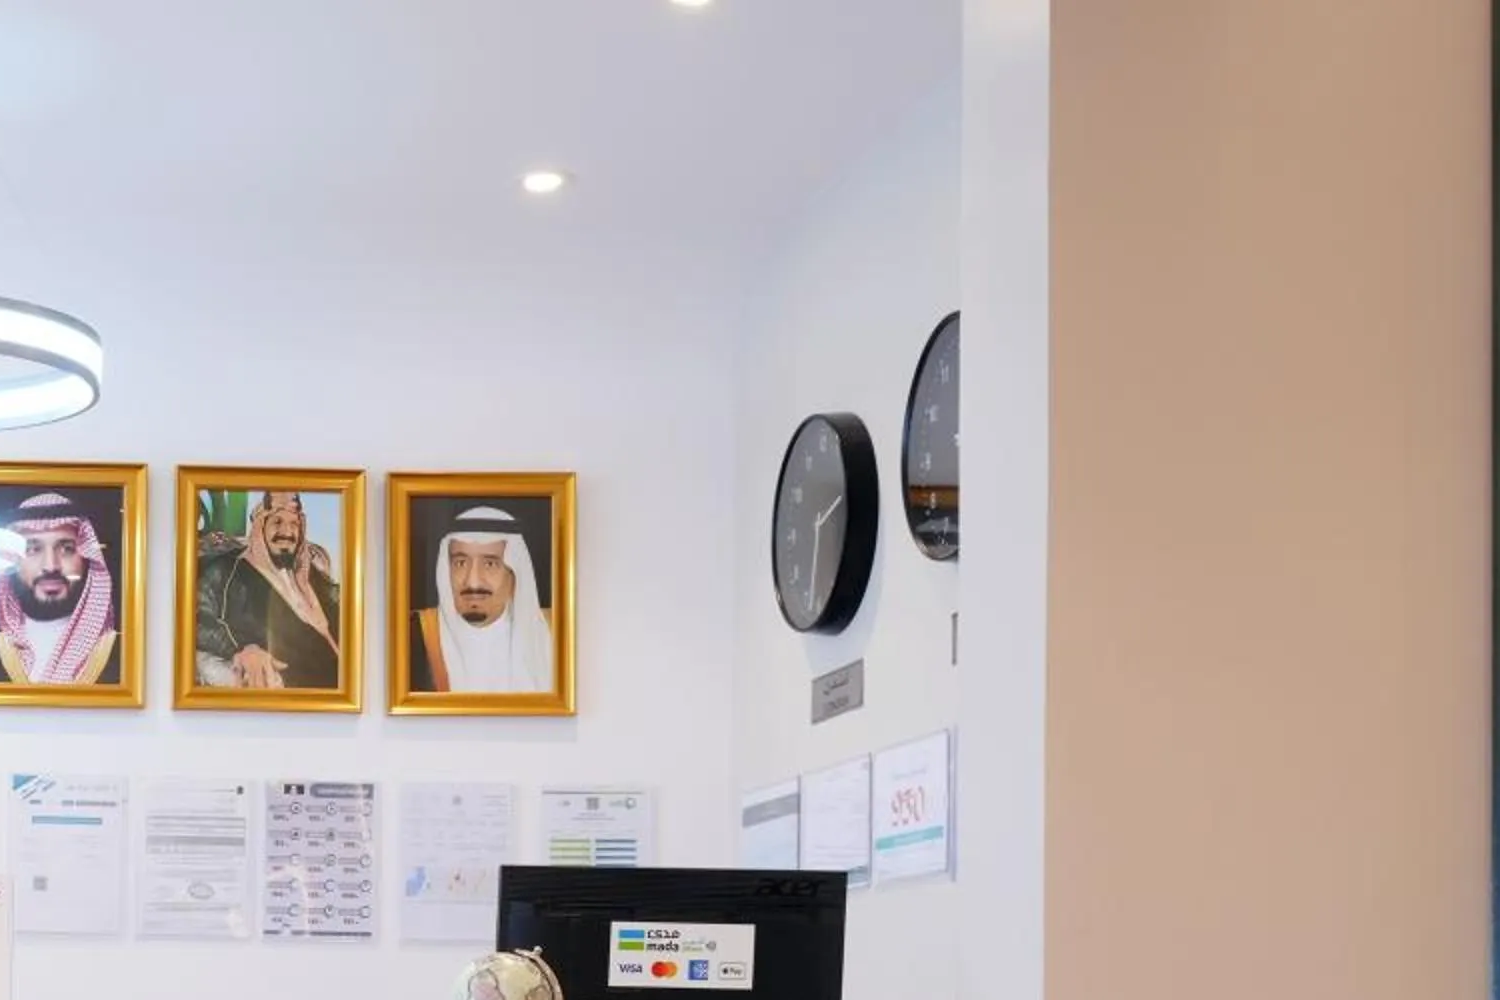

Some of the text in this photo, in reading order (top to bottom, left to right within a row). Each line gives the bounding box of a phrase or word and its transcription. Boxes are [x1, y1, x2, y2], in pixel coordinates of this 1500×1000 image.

[753, 876, 827, 897] acer
[646, 940, 679, 952] mada
[618, 963, 643, 973] VISA
